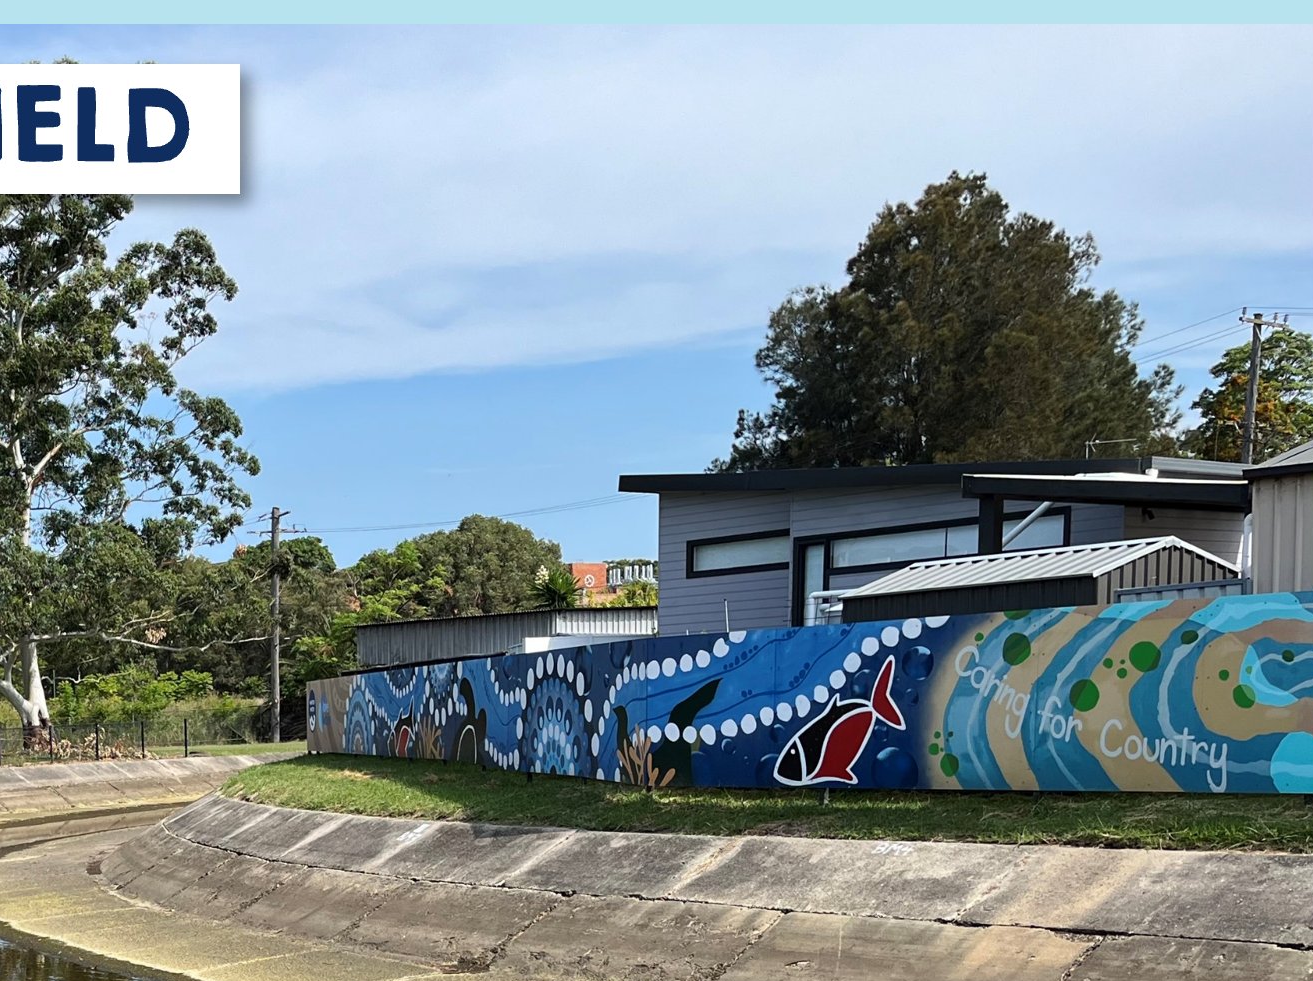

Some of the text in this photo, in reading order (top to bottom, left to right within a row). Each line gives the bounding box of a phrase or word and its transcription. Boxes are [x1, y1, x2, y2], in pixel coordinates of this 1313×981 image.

[954, 645, 1228, 793] Caring for Country
